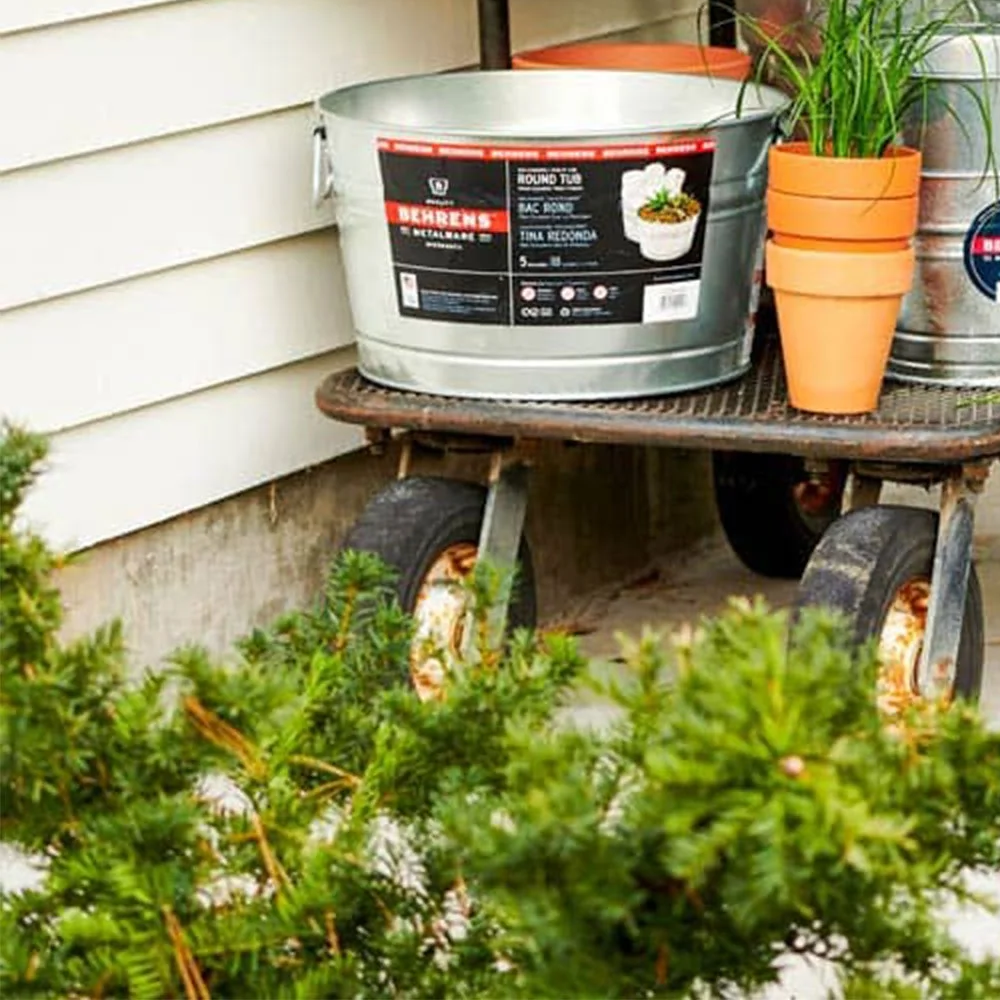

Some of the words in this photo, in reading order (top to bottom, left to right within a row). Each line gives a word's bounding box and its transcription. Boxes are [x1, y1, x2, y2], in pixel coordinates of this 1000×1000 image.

[517, 173, 557, 185] ROUND
[560, 173, 582, 185] TUB
[397, 206, 492, 230] BEHRENS
[547, 229, 598, 242] REDONDA
[519, 256, 528, 268] 5
